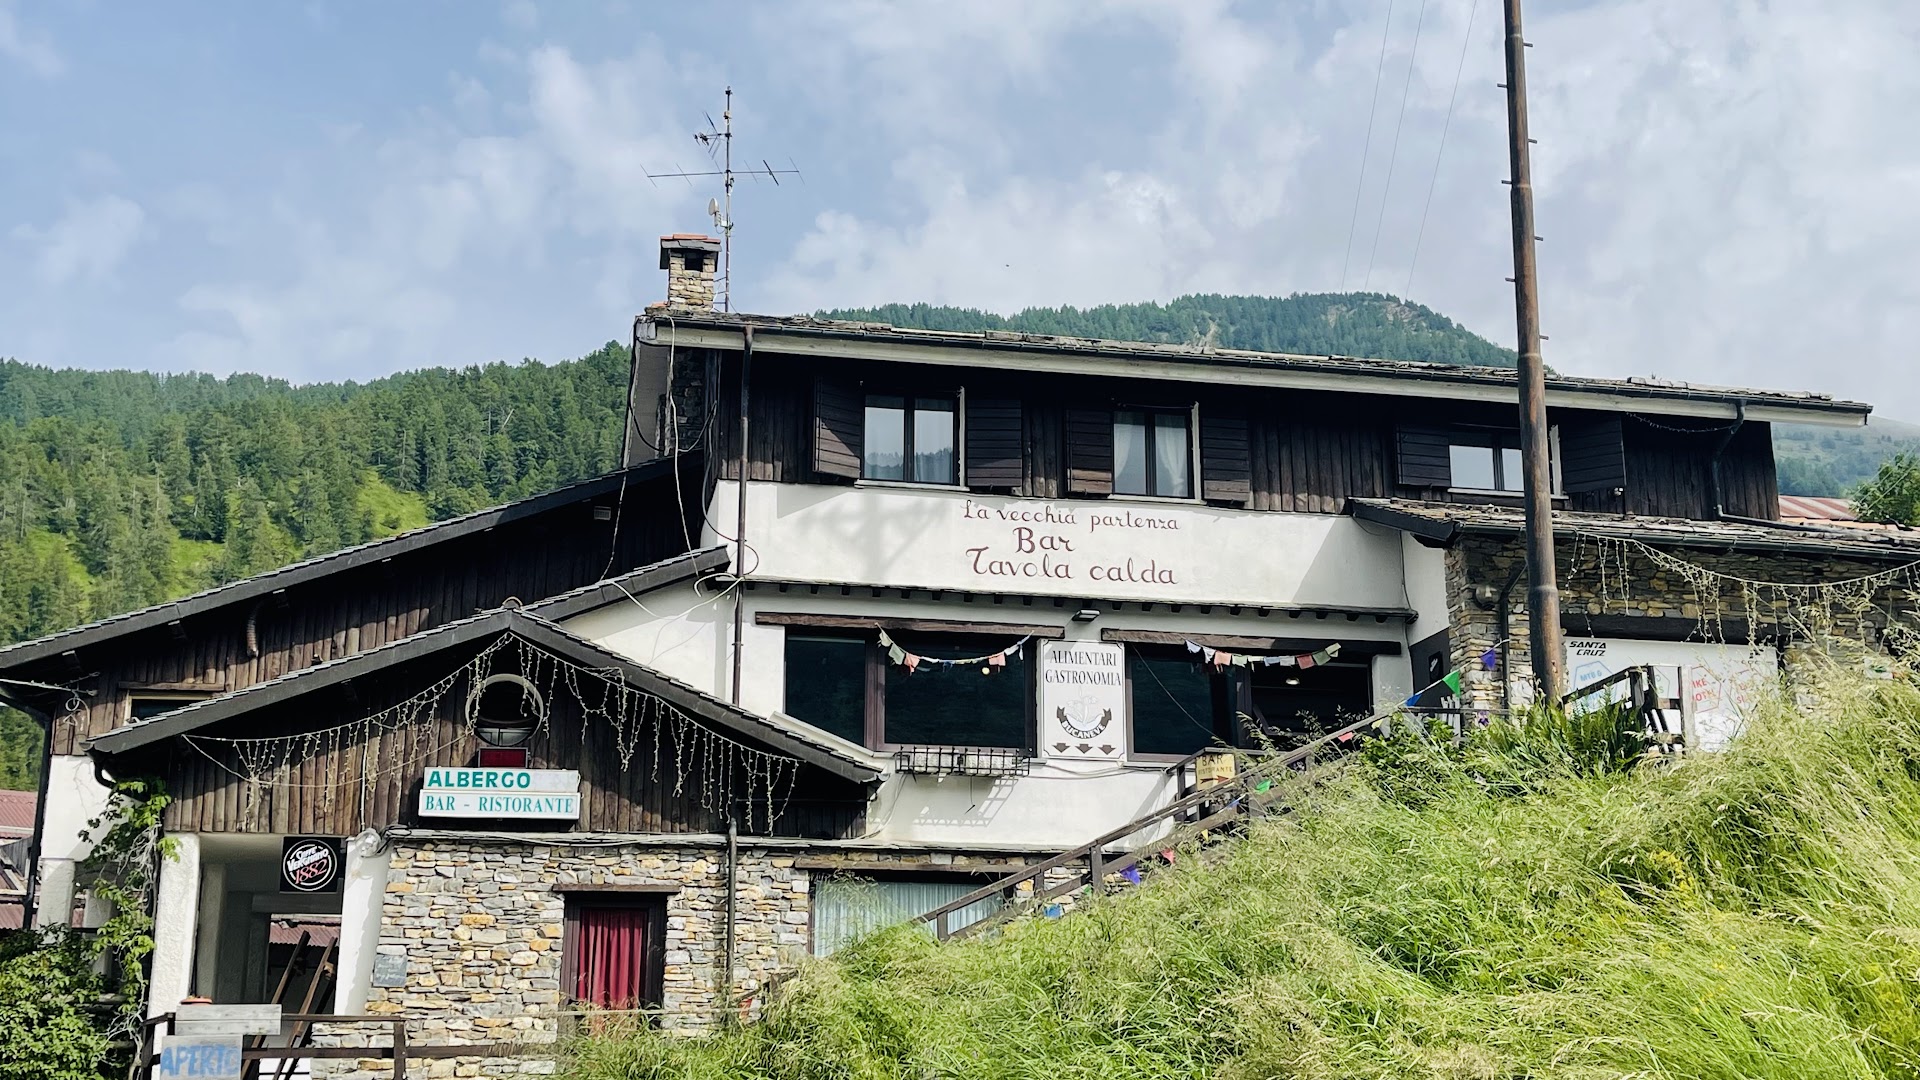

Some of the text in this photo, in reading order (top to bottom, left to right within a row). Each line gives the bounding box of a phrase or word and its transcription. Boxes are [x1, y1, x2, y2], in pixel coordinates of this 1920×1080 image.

[960, 499, 1181, 534] La vecchia partenza
[1012, 526, 1076, 554] Bar
[965, 546, 1179, 585] Tavola calda
[1569, 640, 1607, 649] SANTA
[1576, 649, 1606, 657] CRUZ
[1049, 650, 1117, 667] ALIMENTARI
[1045, 669, 1122, 687] GASTRONOMIA
[1202, 753, 1224, 767] BAR
[427, 770, 531, 789] ALBERGO
[425, 795, 456, 811] BAR
[478, 797, 574, 814] RISTORANTE
[295, 858, 328, 885] 1882
[160, 1044, 241, 1077] APERTO
